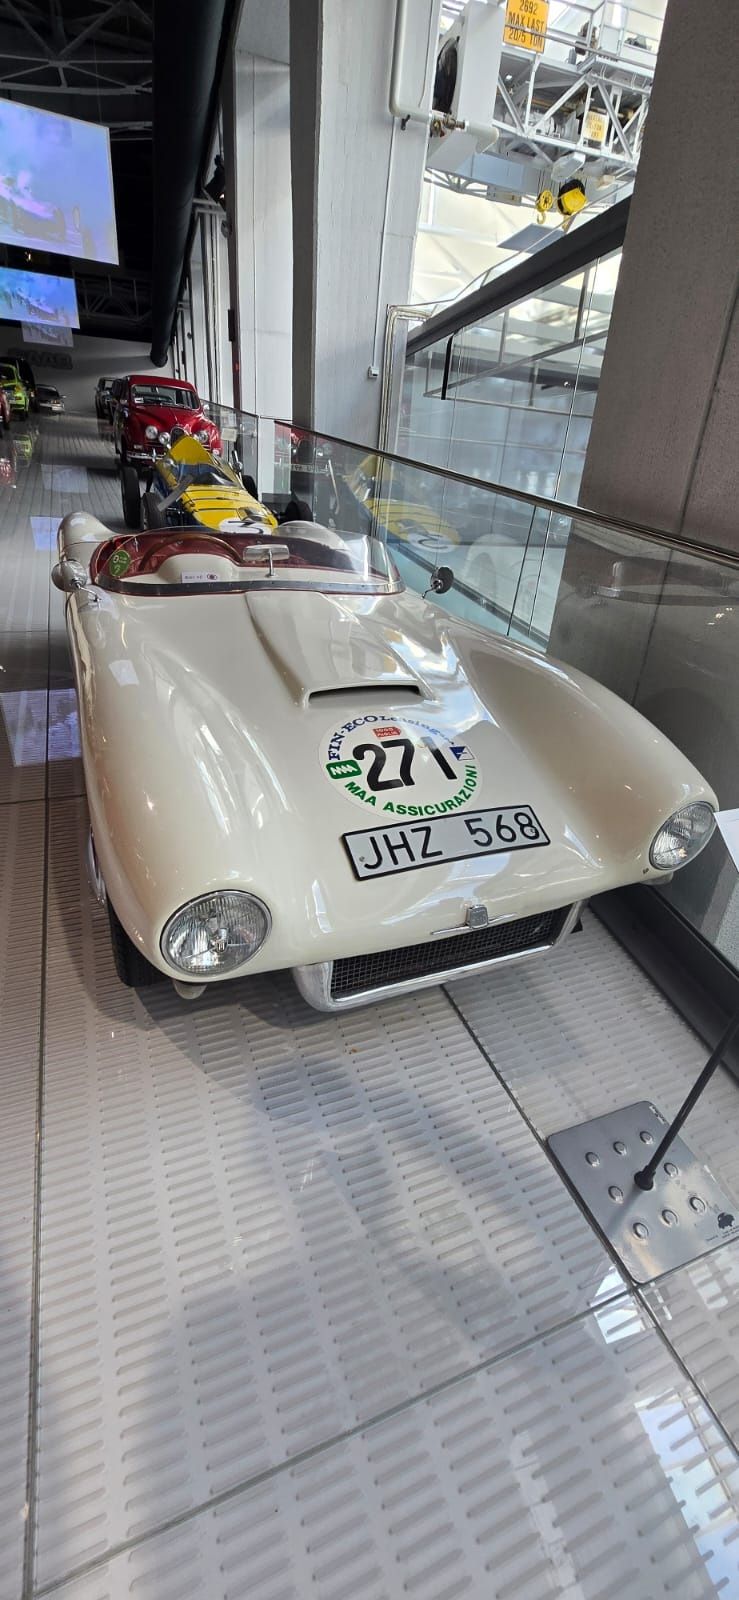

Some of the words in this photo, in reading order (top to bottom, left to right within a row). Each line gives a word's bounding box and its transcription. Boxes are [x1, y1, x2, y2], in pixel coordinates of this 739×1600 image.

[509, 11, 526, 27] MAX
[526, 17, 545, 34] LAST
[529, 32, 543, 49] TON
[352, 736, 458, 791] 271
[344, 781, 377, 807] MAA
[382, 764, 478, 816] ASSICURAZIONI
[363, 825, 443, 870] JHZ
[464, 812, 540, 847] 568
